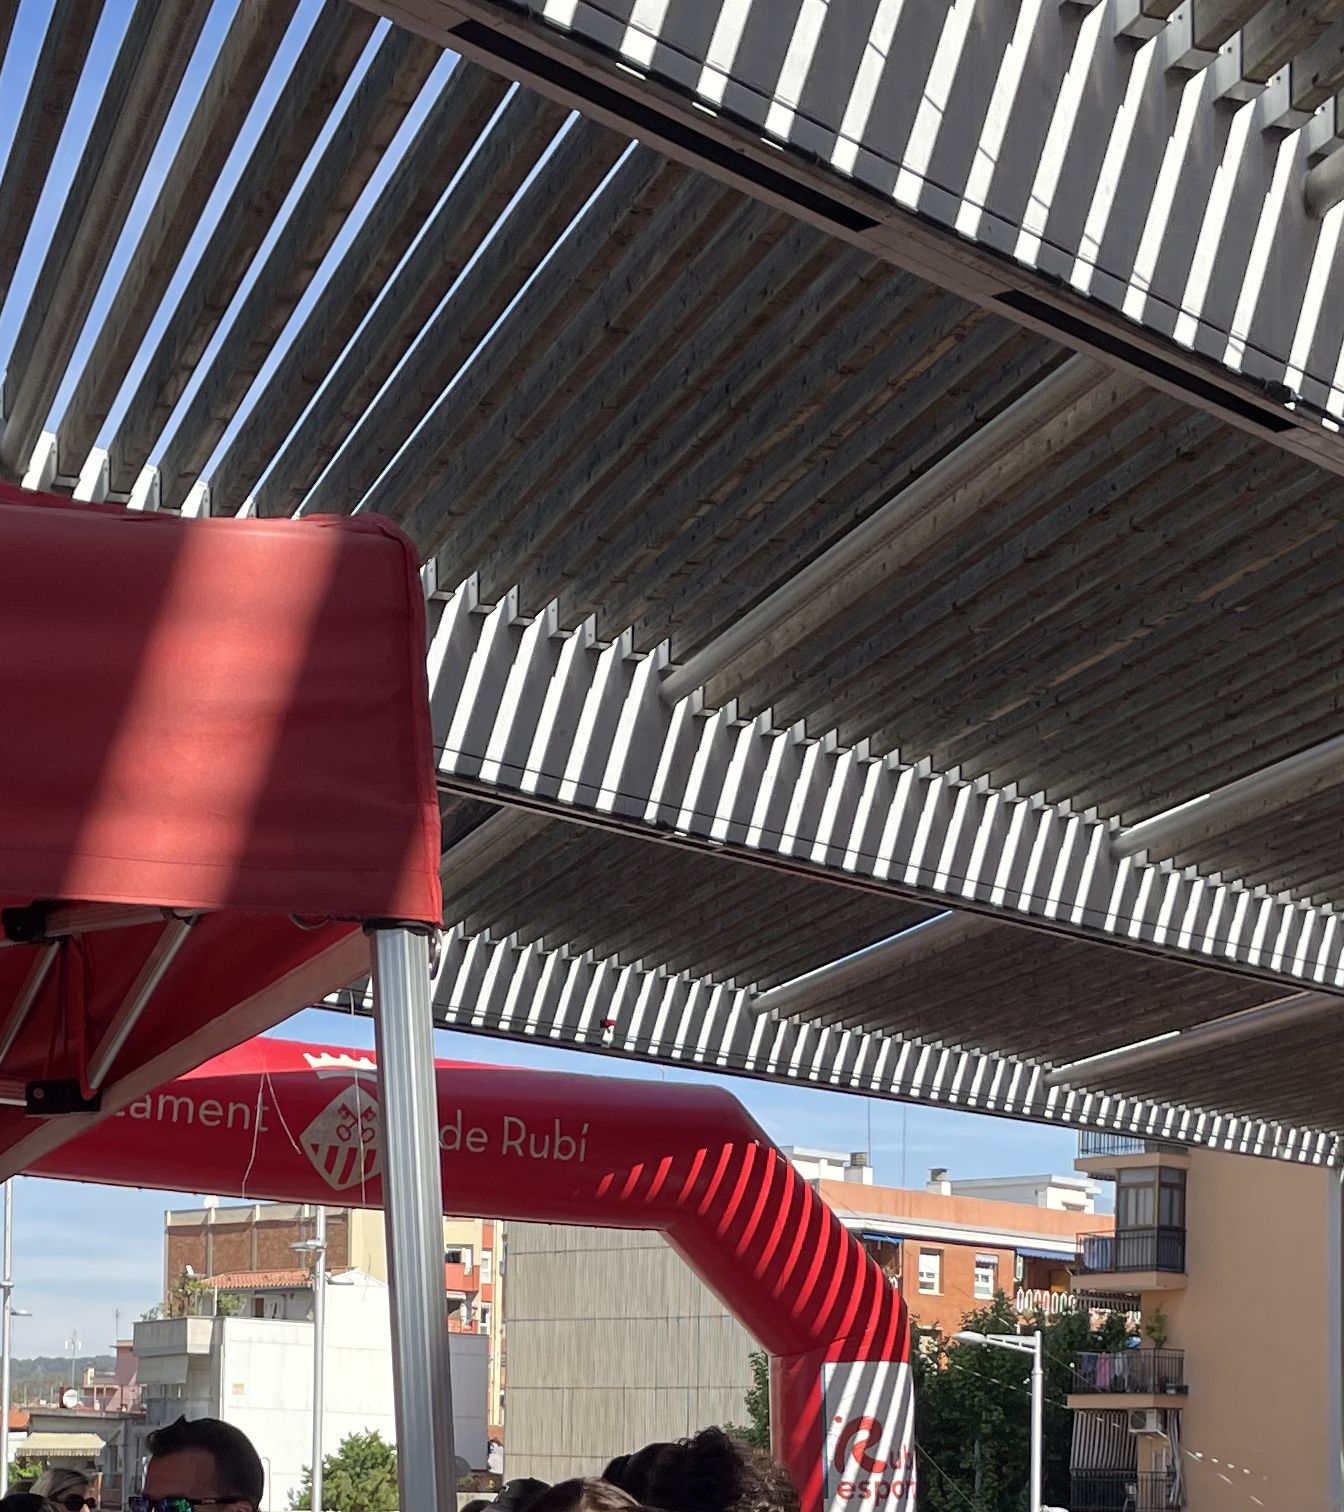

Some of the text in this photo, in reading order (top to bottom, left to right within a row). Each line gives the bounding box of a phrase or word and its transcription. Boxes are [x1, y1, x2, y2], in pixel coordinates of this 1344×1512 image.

[115, 1093, 590, 1162] ament de Rubí
